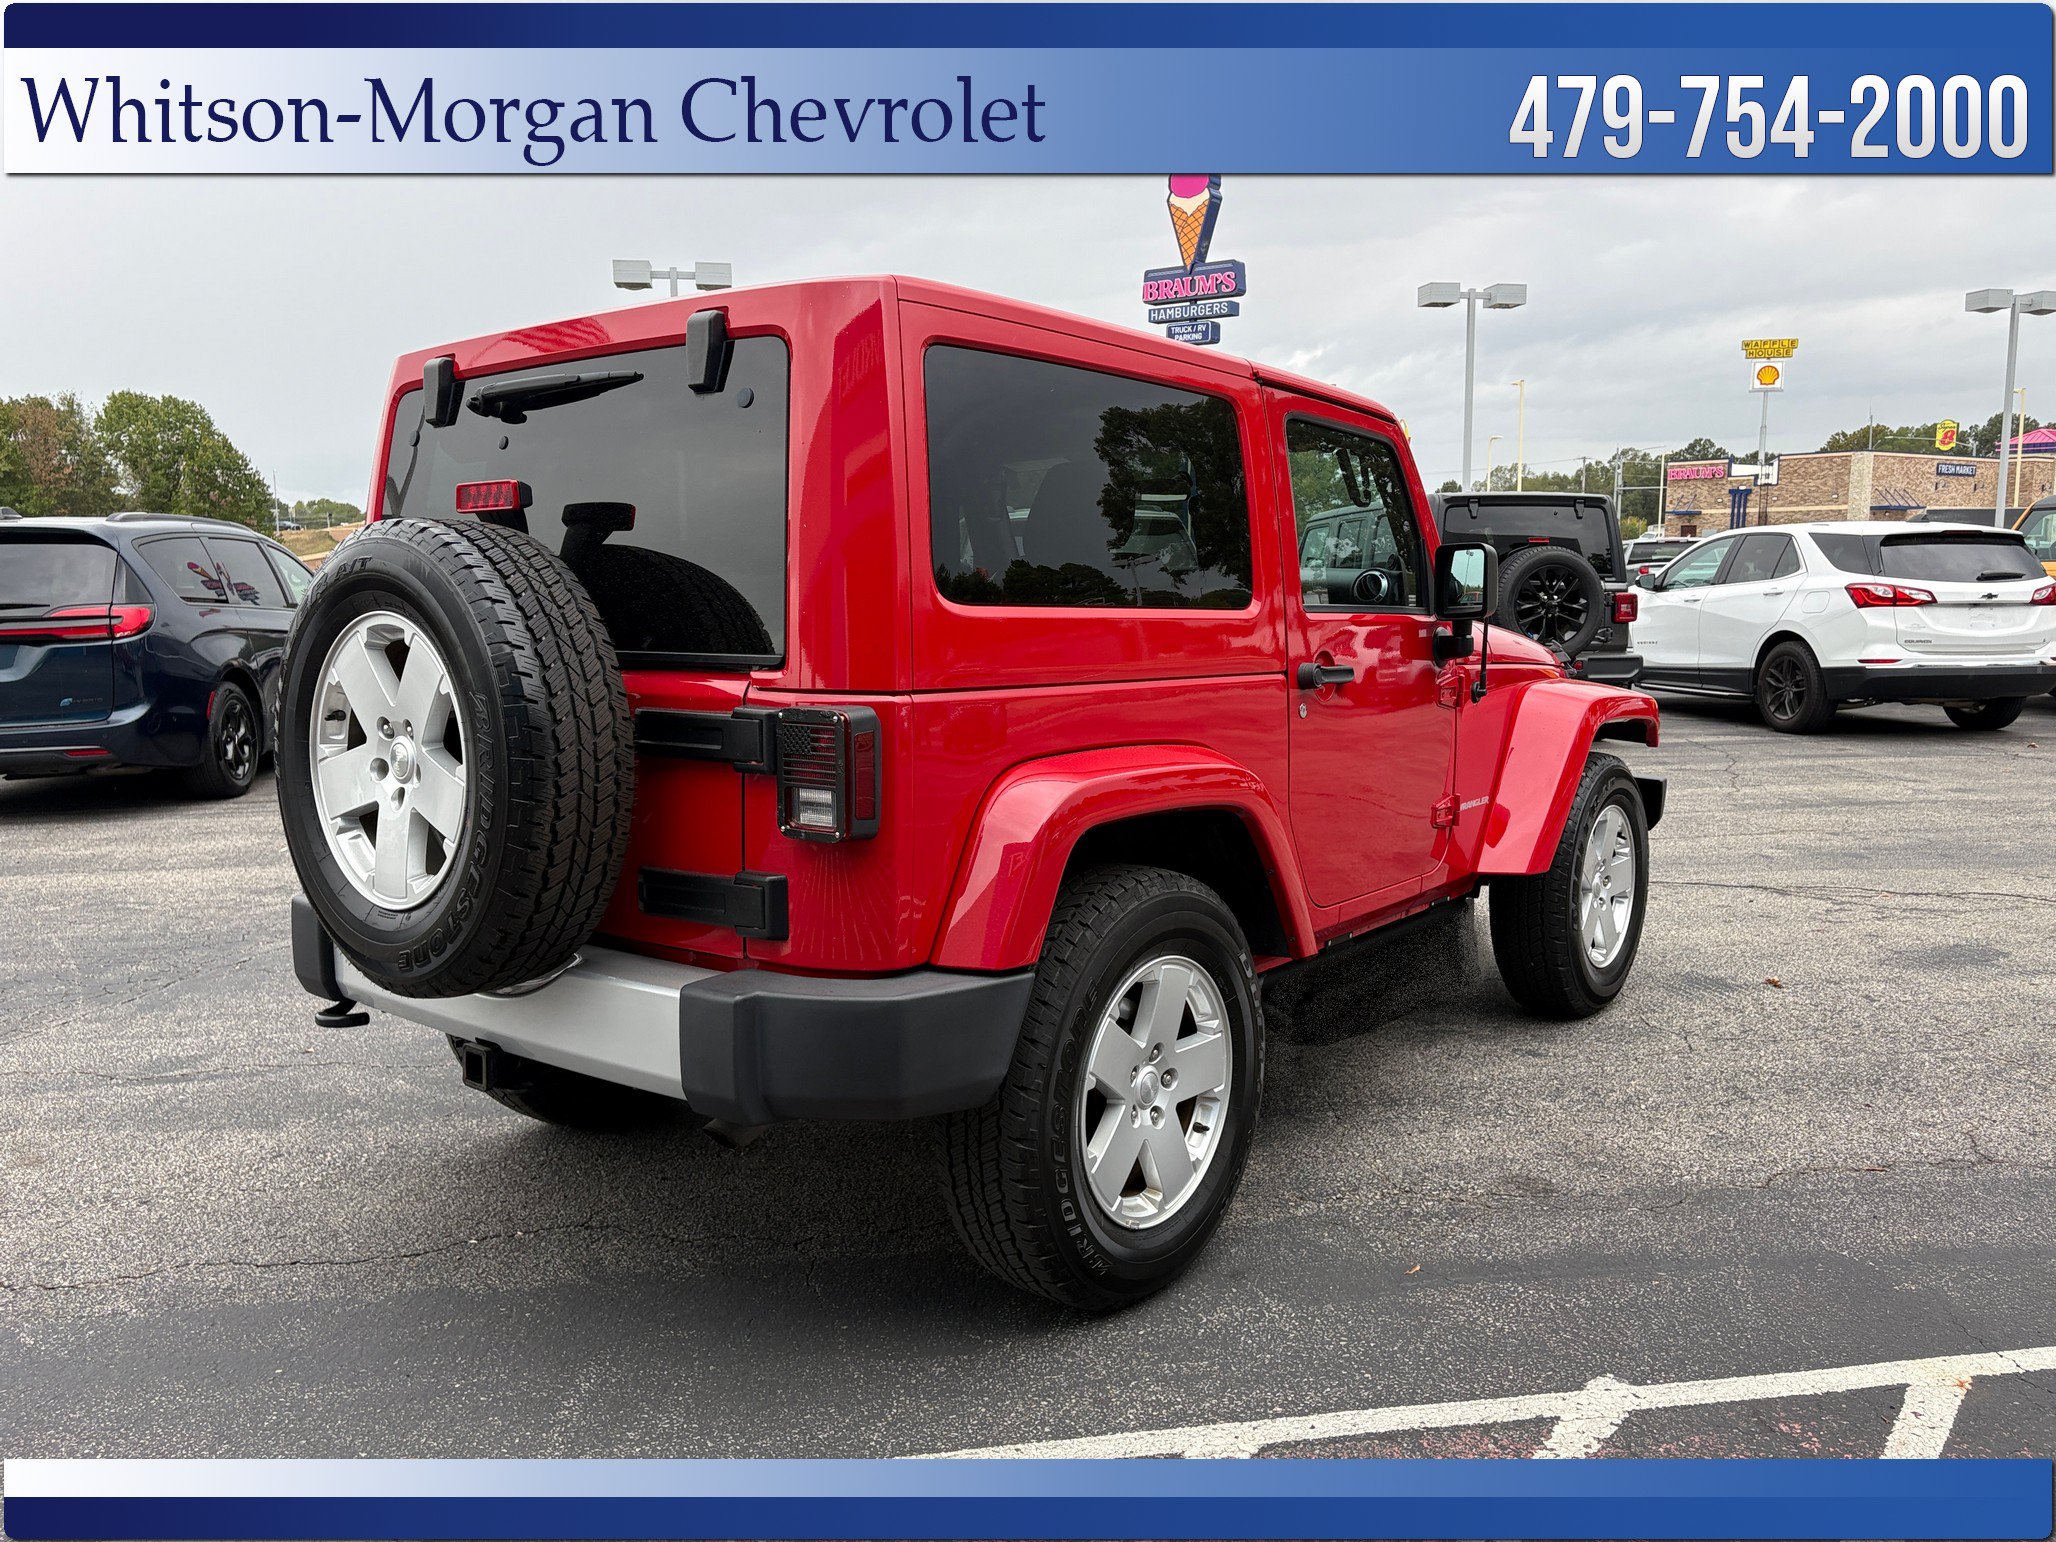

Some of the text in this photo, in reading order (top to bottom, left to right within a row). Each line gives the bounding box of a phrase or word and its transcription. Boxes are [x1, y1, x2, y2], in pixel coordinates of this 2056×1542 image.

[1142, 271, 1236, 301] BRAUM'S
[1151, 303, 1228, 321] HAMBURGERS
[1171, 325, 1192, 334] TRUCK
[1174, 332, 1203, 341] PARKING
[1743, 340, 1797, 348] WAFFLE
[1748, 349, 1791, 357] HOUSE
[1940, 430, 1956, 446] 8
[1667, 466, 1724, 480] BRAUM'S
[1938, 464, 1976, 475] FRESH MARKET
[398, 690, 497, 971] BRIDGESTONE
[1051, 980, 1116, 1278] BRIDGESTONE
